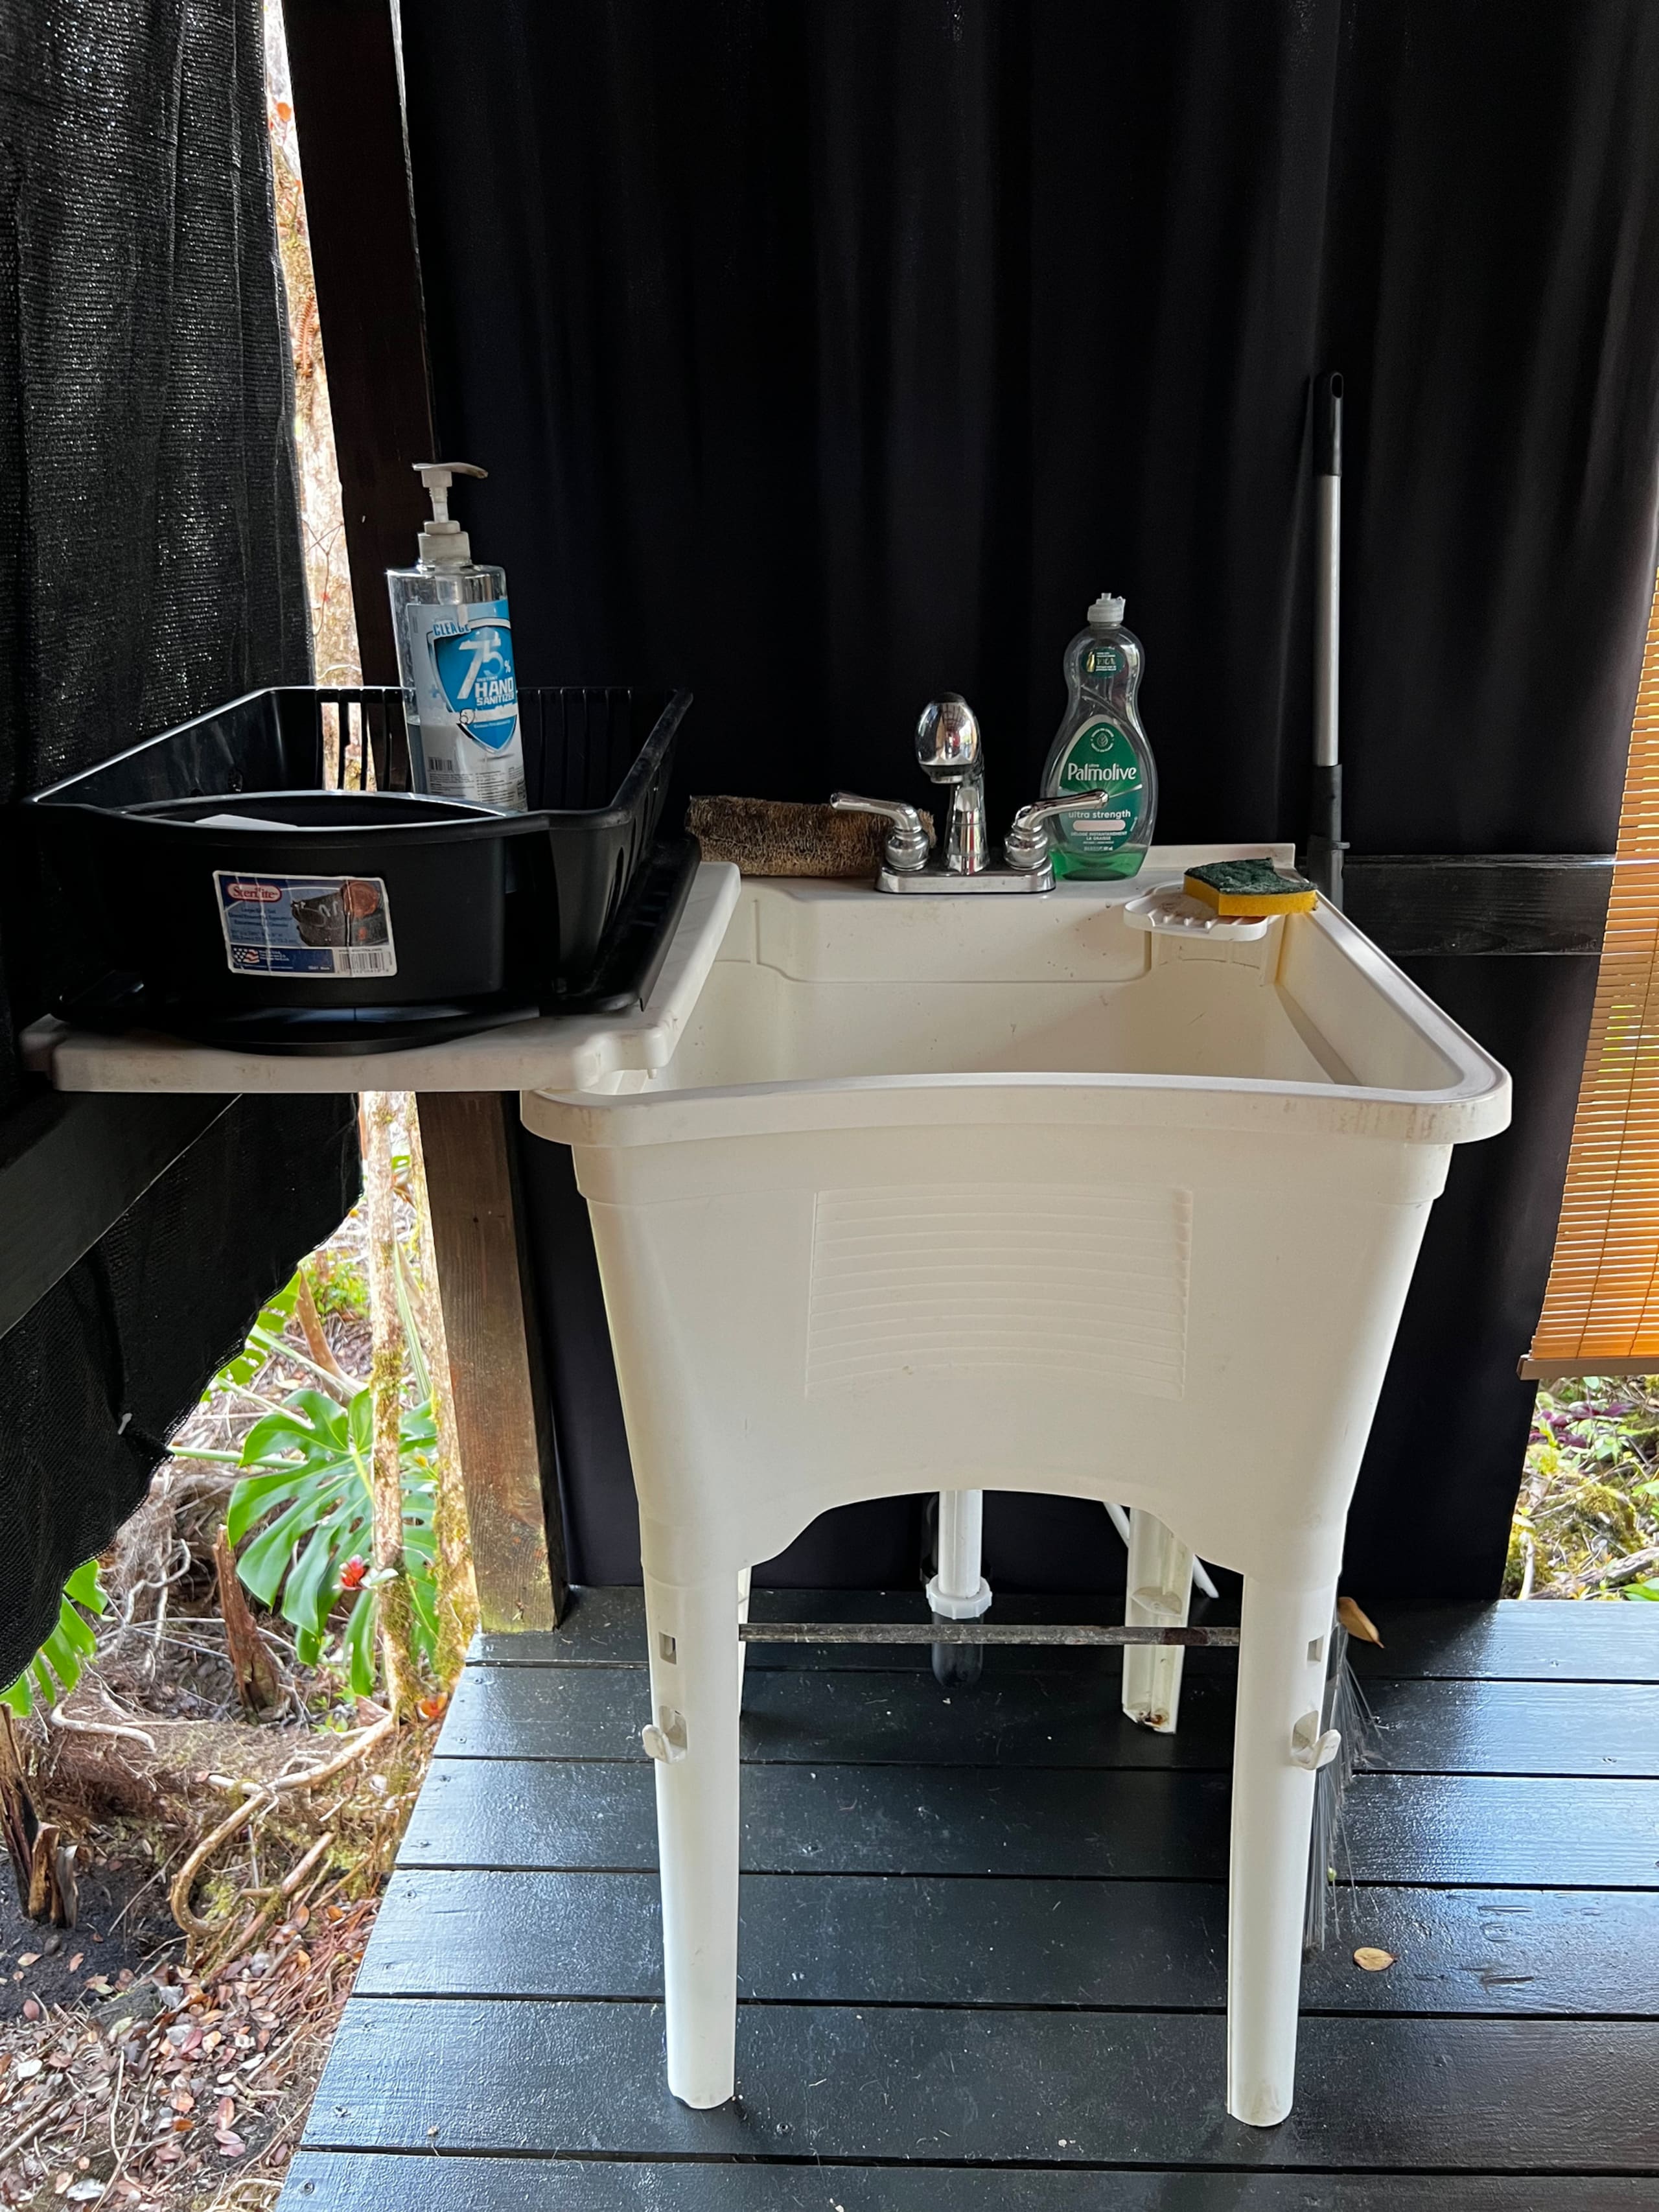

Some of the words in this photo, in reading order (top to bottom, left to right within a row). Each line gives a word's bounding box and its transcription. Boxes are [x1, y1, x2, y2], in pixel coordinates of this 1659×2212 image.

[474, 677, 514, 698] HAND
[1067, 762, 1137, 782] Palmolive
[1093, 809, 1131, 820] strength
